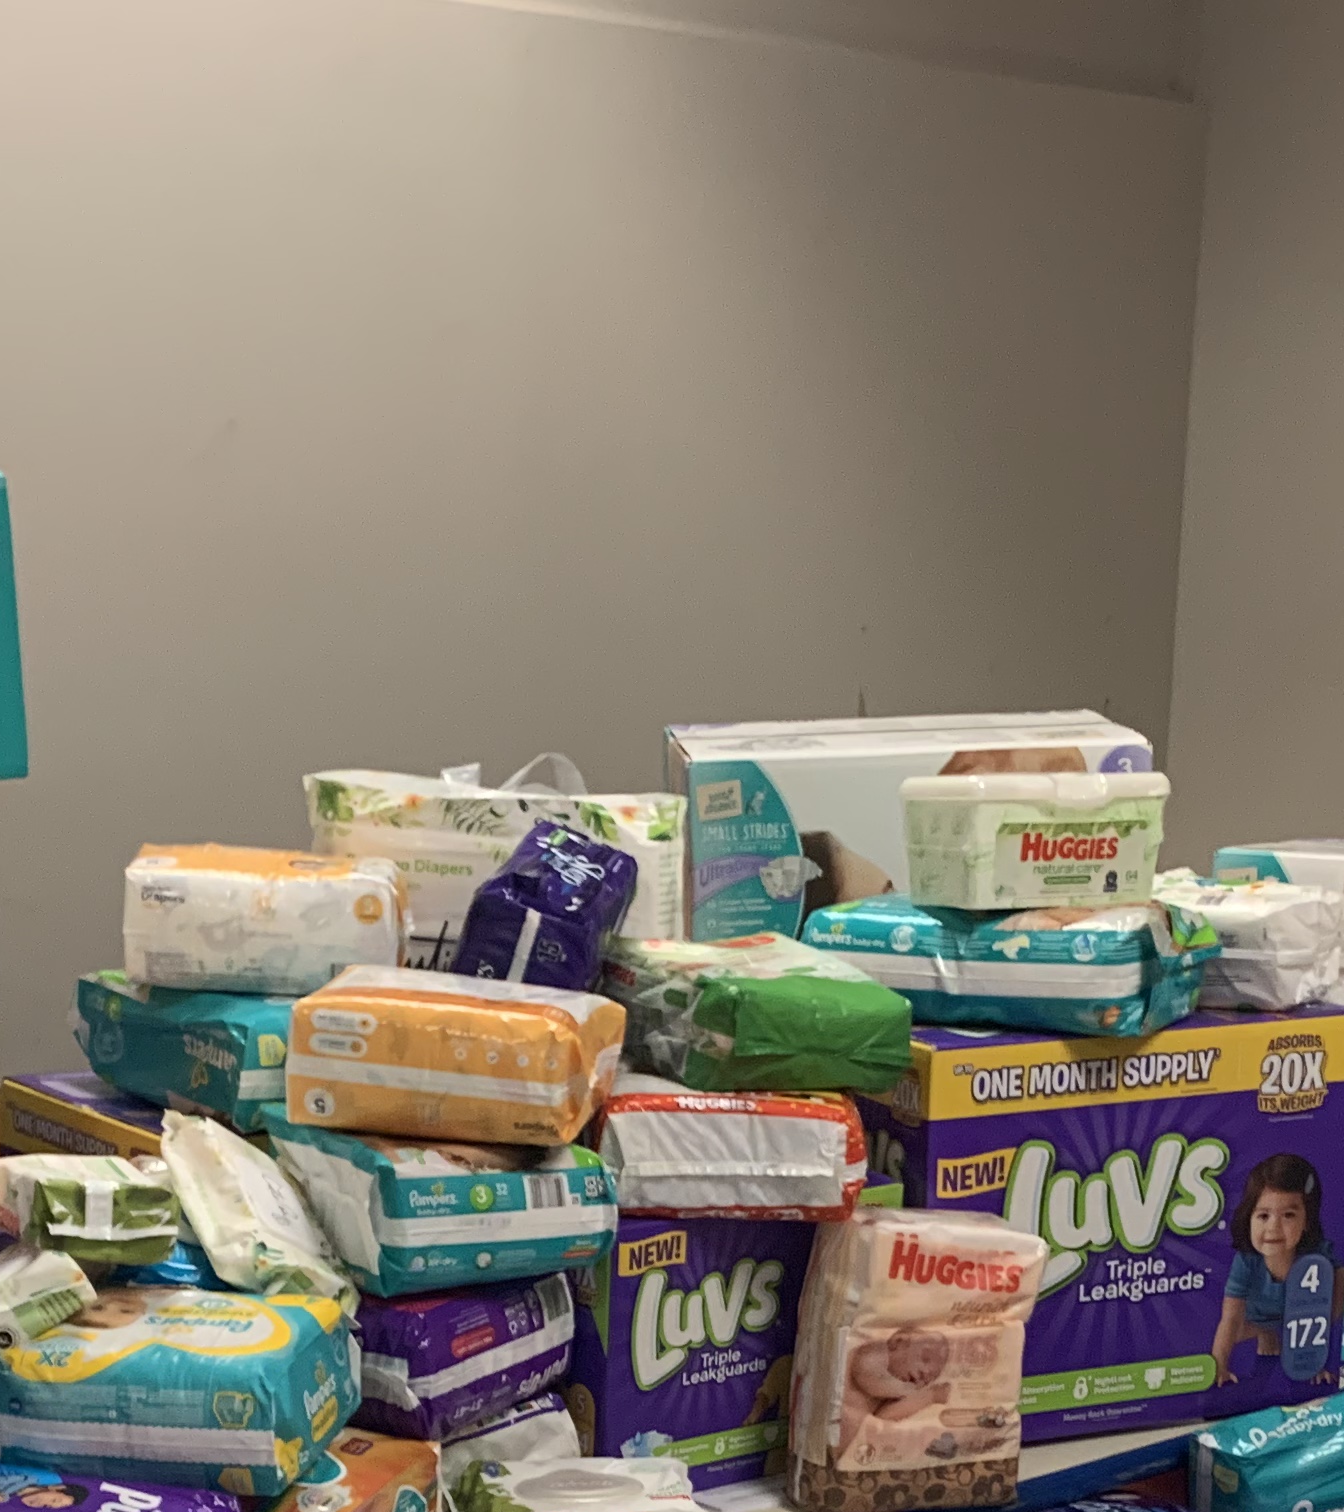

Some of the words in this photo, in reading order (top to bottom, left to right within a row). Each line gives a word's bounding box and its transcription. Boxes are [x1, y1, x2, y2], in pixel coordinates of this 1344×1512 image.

[1020, 832, 1119, 863] HUGGIES
[413, 859, 473, 877] Diapers
[1266, 1034, 1324, 1051] ABSORBS
[971, 1065, 1026, 1101] ONE
[1027, 1055, 1117, 1096] MONTH
[1122, 1049, 1216, 1088] SUPPLY
[1258, 1051, 1326, 1096] 20X
[942, 1154, 1007, 1193] NEW!
[408, 1190, 456, 1208] Pampers
[476, 1185, 487, 1203] 3
[1007, 1133, 1229, 1301] Luvs
[628, 1235, 682, 1270] NEW!
[1106, 1256, 1166, 1283] Triple
[1300, 1265, 1320, 1293] 4
[1078, 1271, 1205, 1302] Leakguards
[631, 1258, 784, 1391] Luvs
[1286, 1316, 1327, 1349] 172
[682, 1359, 766, 1386] Leakguards
[700, 1349, 742, 1368] Triple
